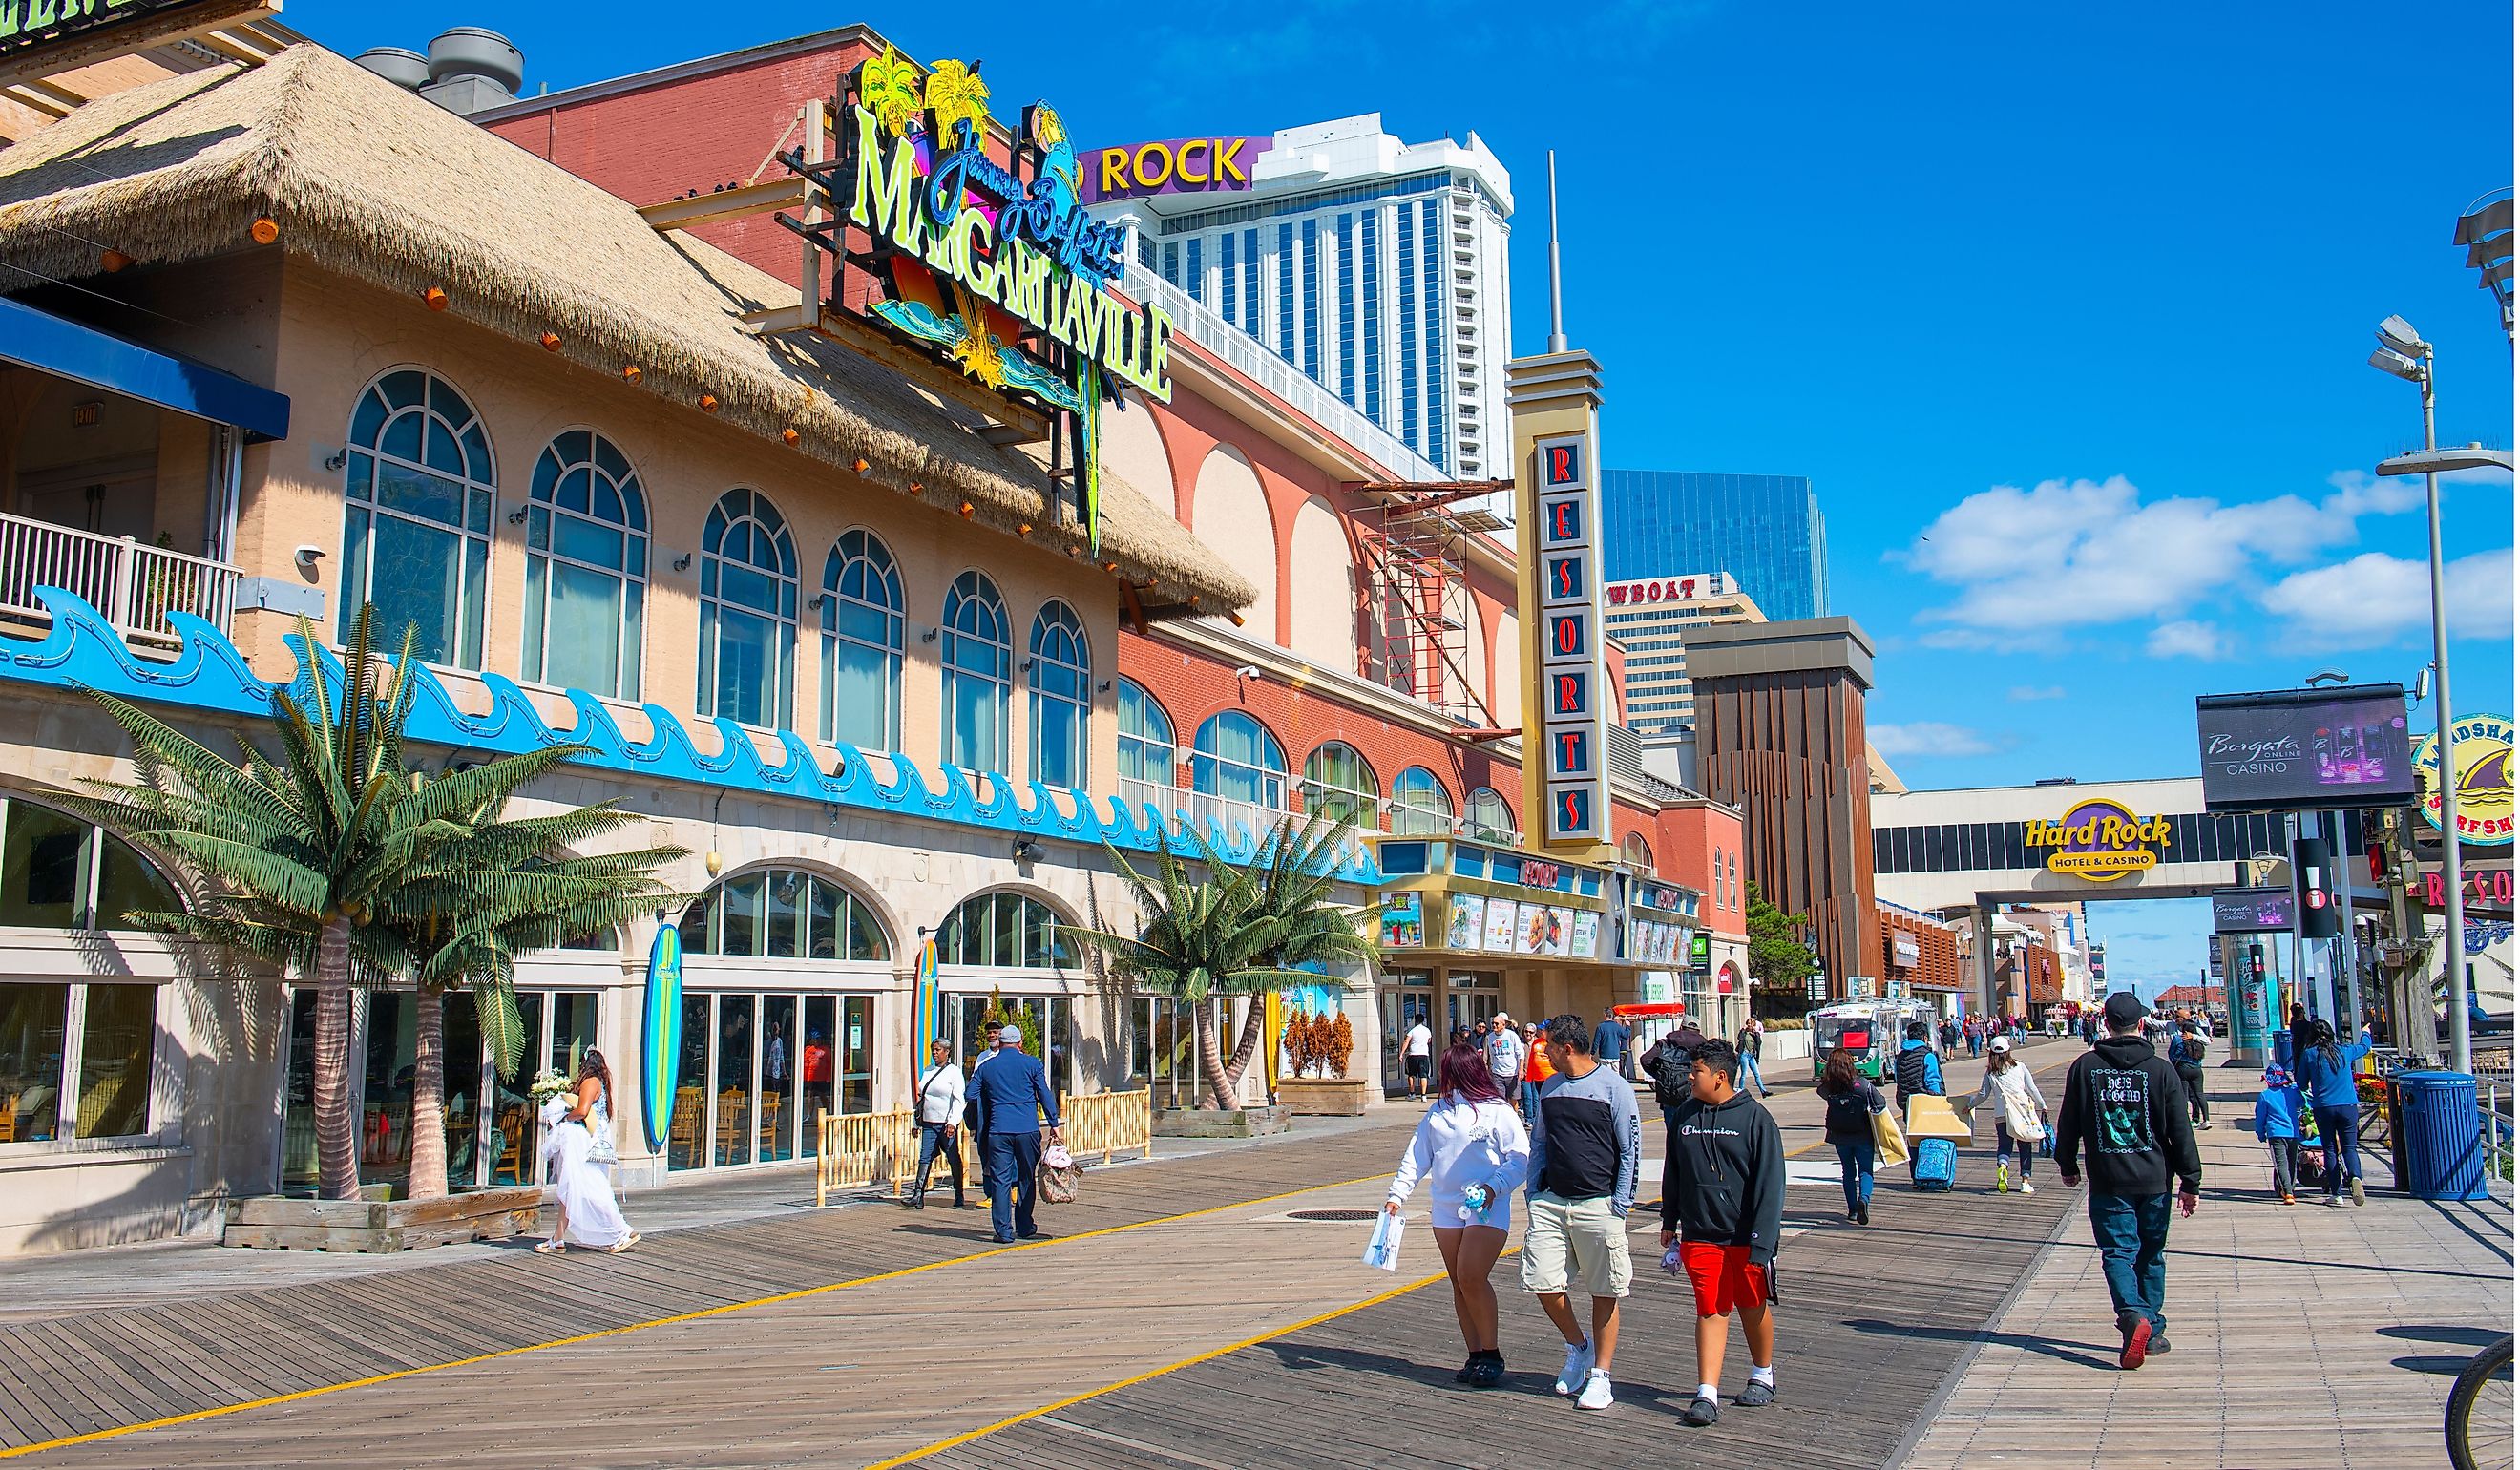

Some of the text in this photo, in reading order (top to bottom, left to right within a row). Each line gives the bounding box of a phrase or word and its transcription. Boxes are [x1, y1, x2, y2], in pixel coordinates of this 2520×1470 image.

[930, 117, 1025, 242] Jimmy
[1102, 138, 1248, 192] ROCK
[850, 103, 1174, 406] MARGARITAVILLE
[1605, 578, 1696, 605] WBOAT
[1552, 448, 1580, 830] RESORTS
[2208, 733, 2300, 763] Borgata
[2227, 762, 2287, 776] CASINO
[2025, 813, 2172, 850] Hard Rock
[2428, 795, 2513, 835] SRFSH
[2055, 855, 2150, 868] HOTEL & CASINO
[1681, 1124, 1740, 1138] Champion
